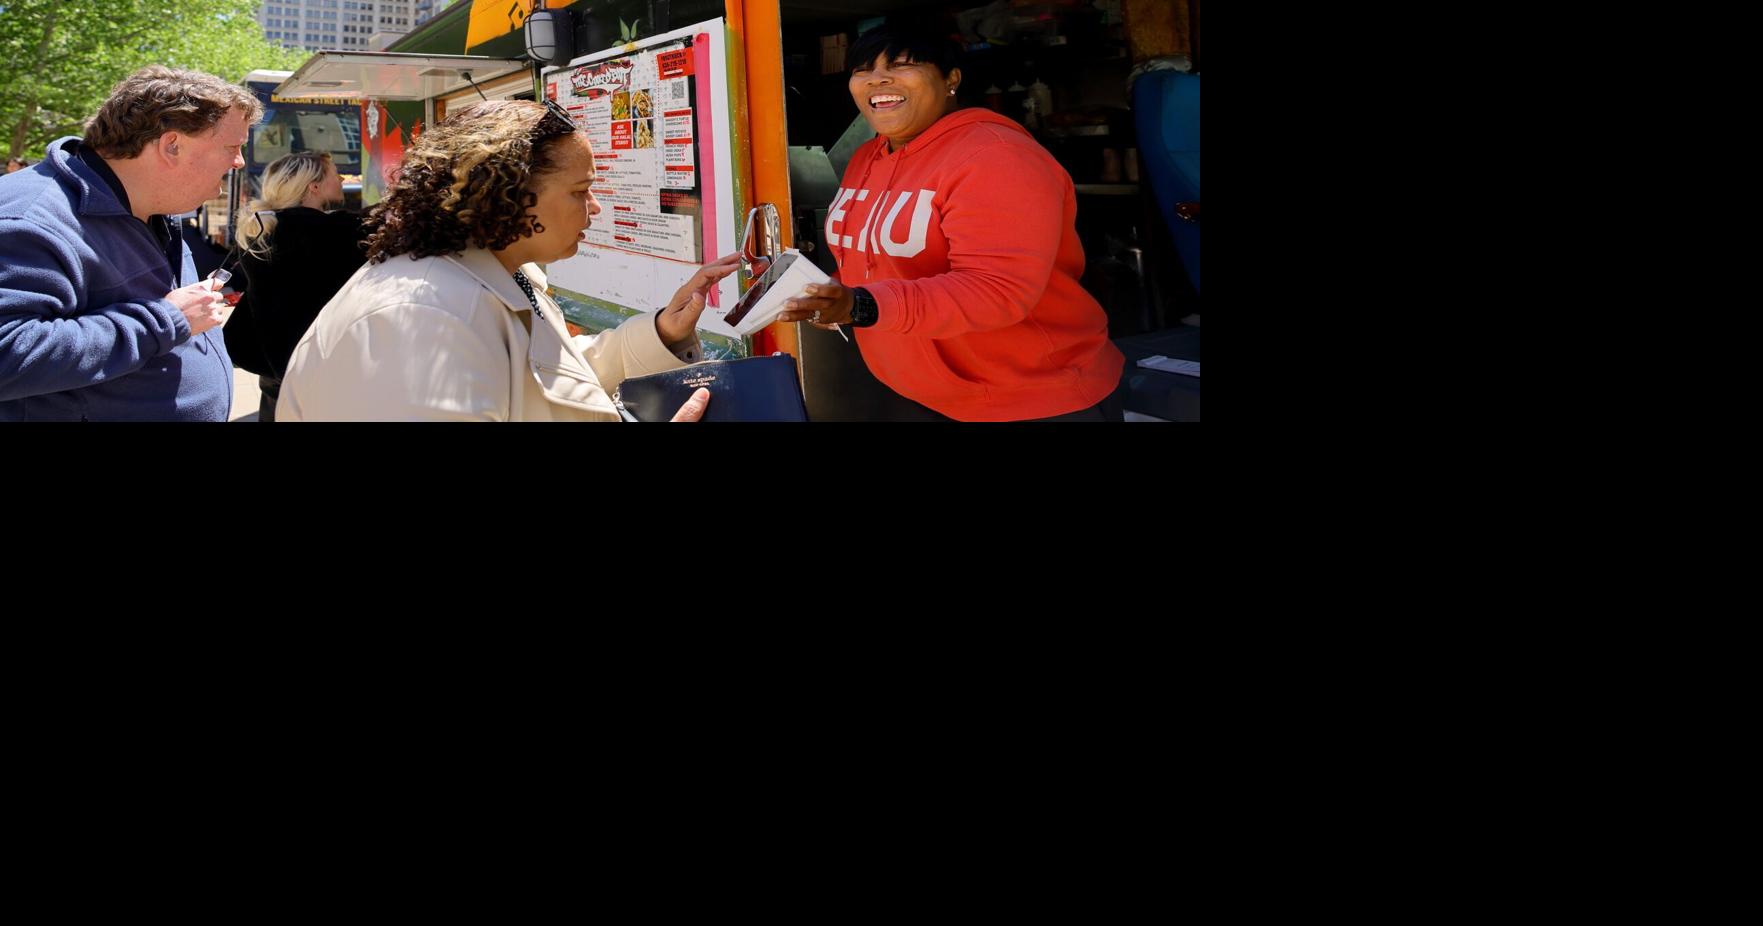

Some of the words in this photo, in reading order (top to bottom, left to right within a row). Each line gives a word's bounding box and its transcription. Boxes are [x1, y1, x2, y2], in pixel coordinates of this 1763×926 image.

[271, 95, 312, 103] MEXICAN
[313, 96, 344, 105] STREET
[697, 375, 716, 383] spade
